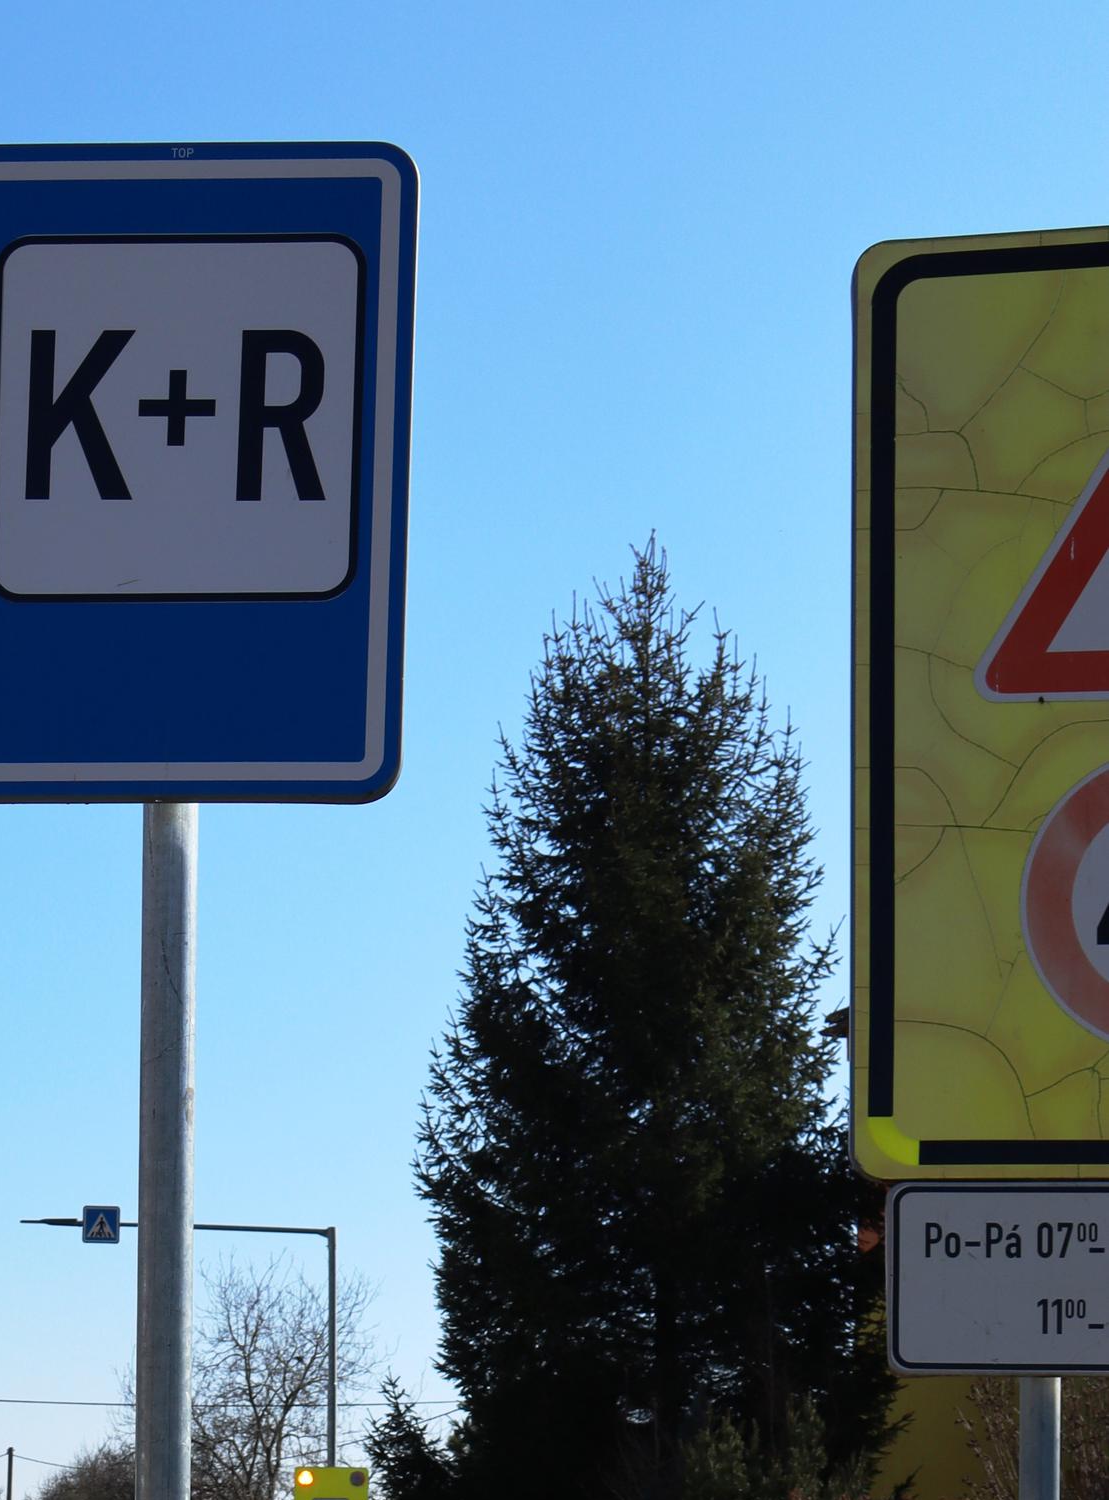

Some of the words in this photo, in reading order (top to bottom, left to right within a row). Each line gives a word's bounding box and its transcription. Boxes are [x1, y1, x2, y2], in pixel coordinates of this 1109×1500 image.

[171, 147, 194, 158] TOP
[25, 329, 326, 501] K+R
[924, 1222, 1022, 1259] Po-Pá
